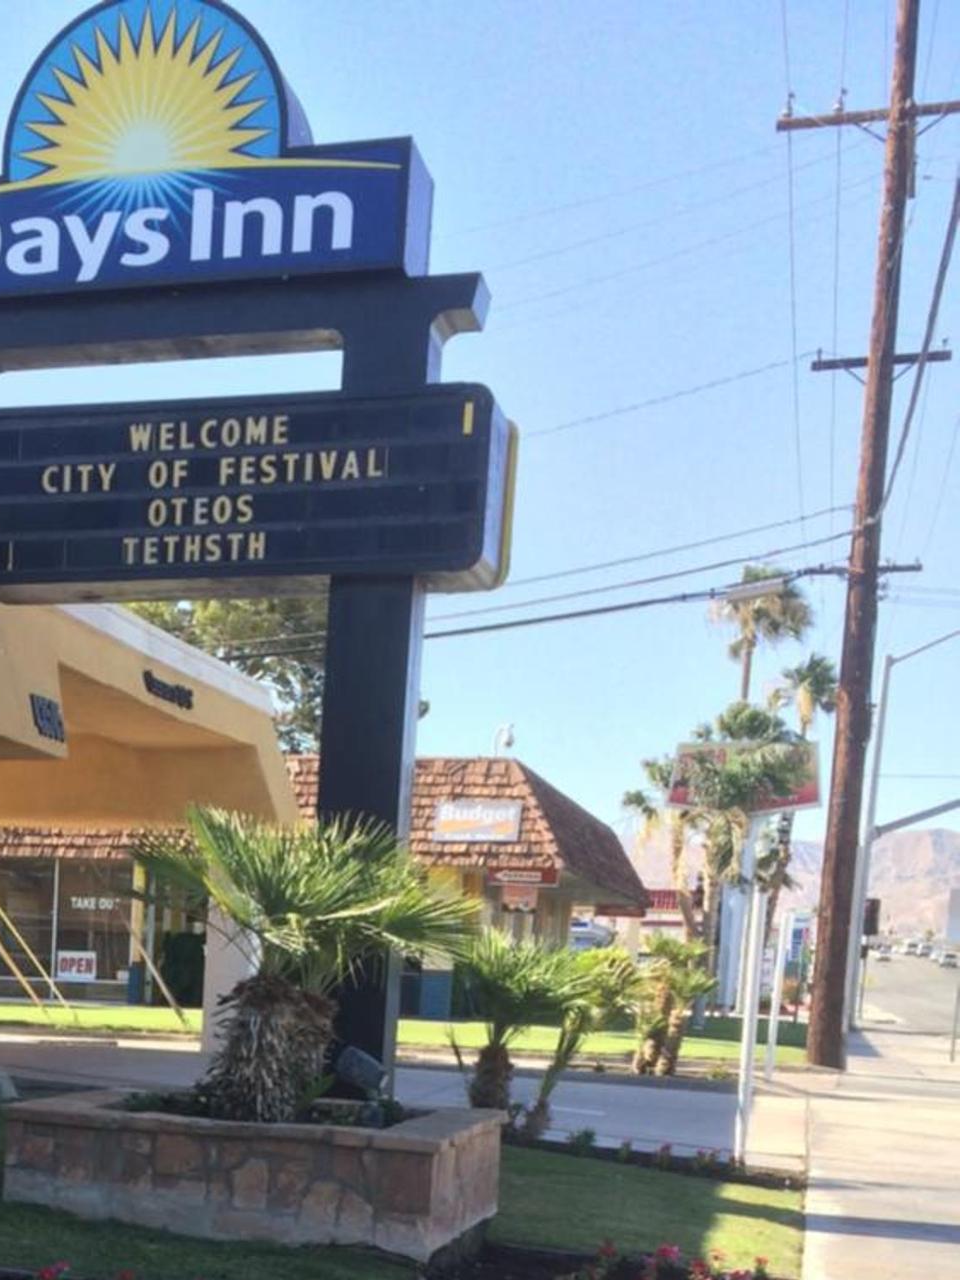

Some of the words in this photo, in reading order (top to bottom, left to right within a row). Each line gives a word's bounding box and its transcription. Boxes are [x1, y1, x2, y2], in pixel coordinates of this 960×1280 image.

[190, 188, 354, 261] Inn
[129, 415, 289, 451] WELCOME
[42, 463, 116, 494] CITY
[149, 460, 188, 489] OF
[219, 449, 383, 486] FESTIVAL
[148, 495, 254, 528] OTEOS
[123, 532, 266, 566] TETHSTH
[438, 802, 517, 822] Budget
[70, 896, 97, 910] TAKE
[60, 956, 94, 974] OPEN
